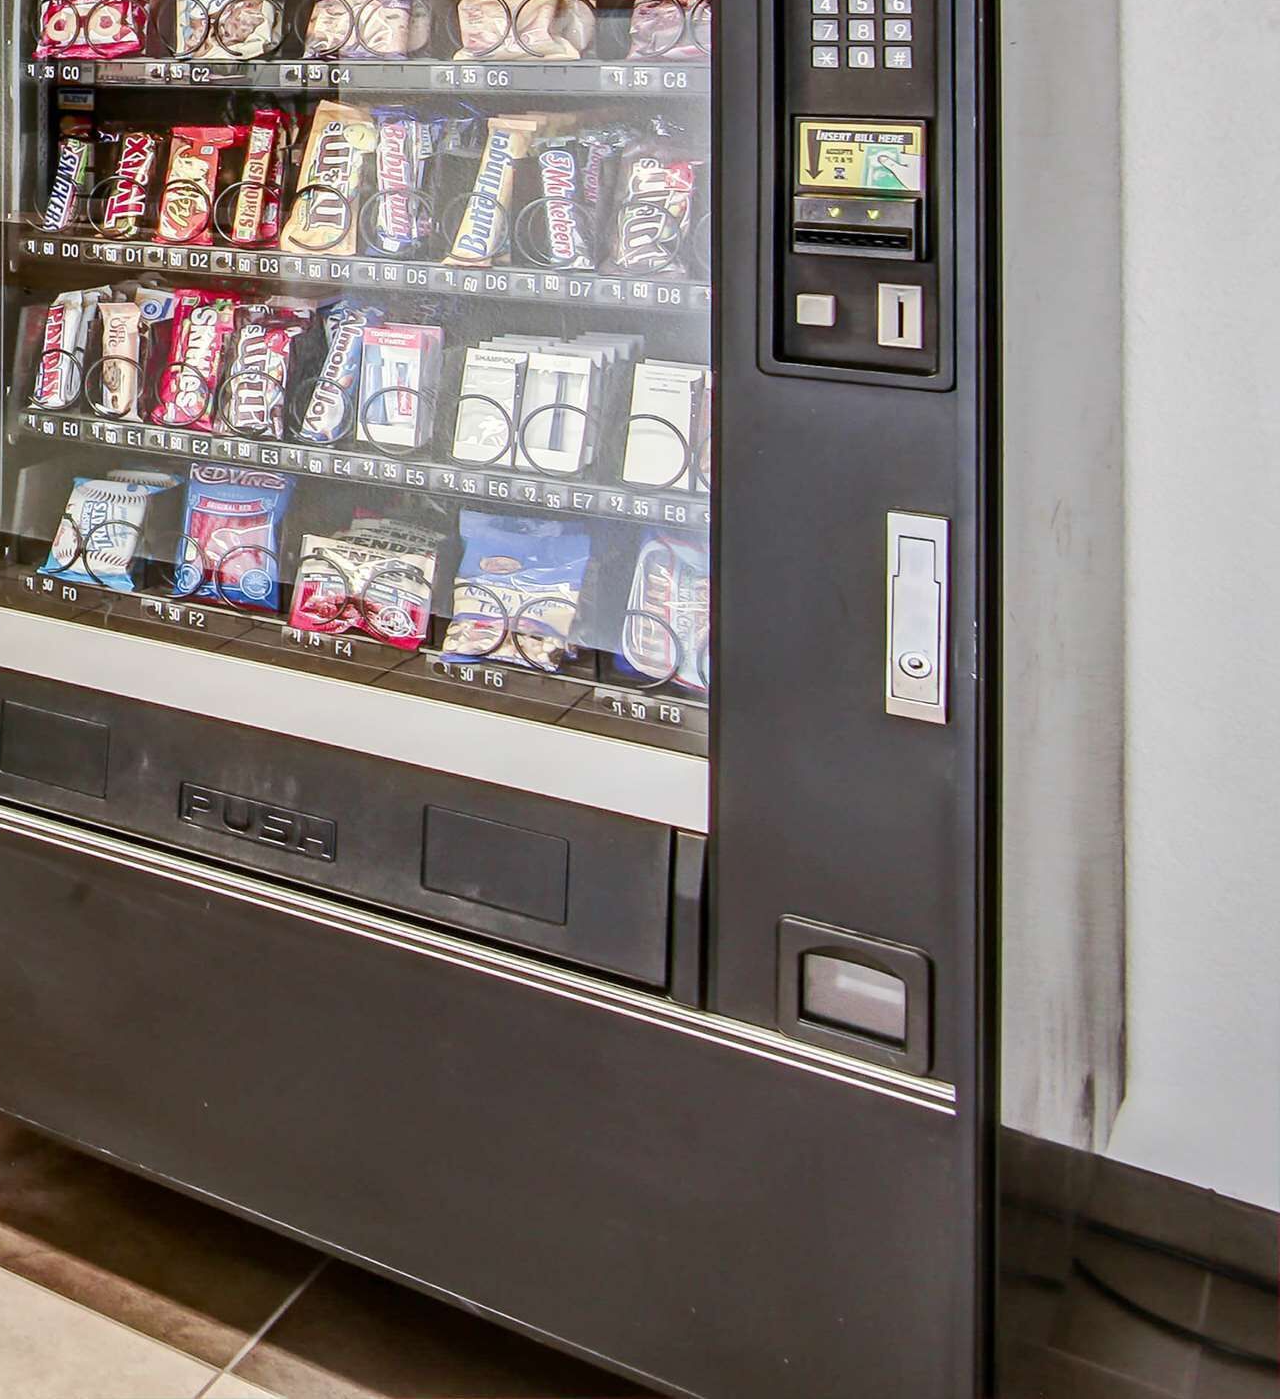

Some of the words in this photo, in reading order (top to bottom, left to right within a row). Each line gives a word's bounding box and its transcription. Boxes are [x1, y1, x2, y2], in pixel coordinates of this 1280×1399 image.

[823, 25, 833, 38] 7
[858, 25, 869, 39] 8
[895, 24, 906, 38] 9
[858, 51, 868, 65] 0
[62, 66, 79, 80] C0
[192, 67, 210, 81] C2
[331, 68, 350, 83] C4
[487, 70, 509, 86] C6
[663, 72, 687, 88] C8
[816, 130, 852, 142] INSERT
[855, 132, 875, 143] BILL
[878, 133, 905, 144] HERE
[43, 142, 81, 232] SNICKERS
[104, 134, 151, 227] TWIX
[456, 129, 514, 257] Butterfinger
[544, 167, 574, 258] Muketeers
[62, 244, 79, 258] D0
[126, 249, 142, 262] D1
[190, 253, 208, 268] D2
[259, 259, 279, 274] D3
[331, 263, 350, 279] D4
[406, 269, 427, 285] D5
[485, 274, 508, 291] D6
[569, 281, 593, 298] D7
[657, 288, 681, 304] D8
[62, 422, 79, 436] E0
[127, 431, 142, 445] E1
[192, 440, 209, 455] E2
[261, 450, 279, 464] E3
[333, 460, 352, 474] E4
[406, 469, 425, 486] E5
[488, 482, 509, 498] E6
[573, 493, 594, 508] E7
[664, 505, 686, 522] E8
[62, 587, 77, 601] F0
[189, 611, 205, 627] F2
[335, 640, 352, 657] F4
[485, 671, 504, 687] F6
[659, 705, 681, 723] F8
[182, 794, 333, 860] PUSH
